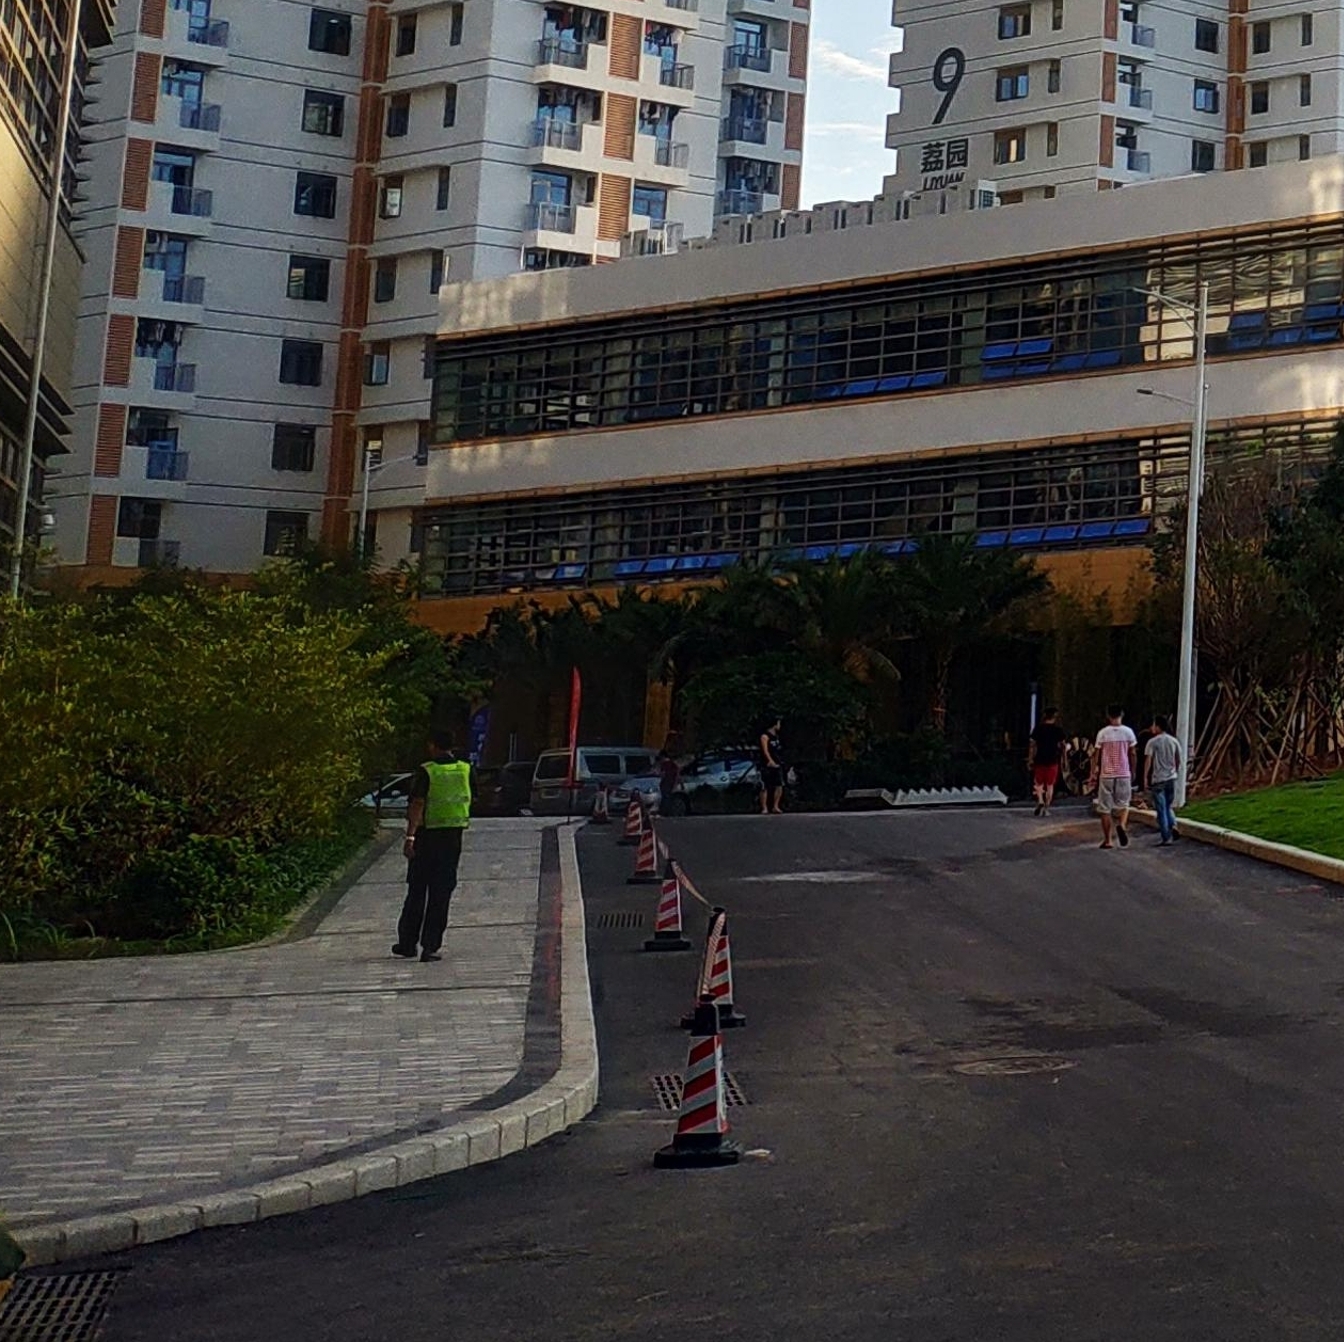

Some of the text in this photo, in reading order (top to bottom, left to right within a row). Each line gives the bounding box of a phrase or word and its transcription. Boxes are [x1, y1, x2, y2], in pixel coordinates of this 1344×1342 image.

[933, 47, 966, 125] 9
[920, 138, 969, 173] 荔园
[922, 171, 965, 191] LIYUAN
